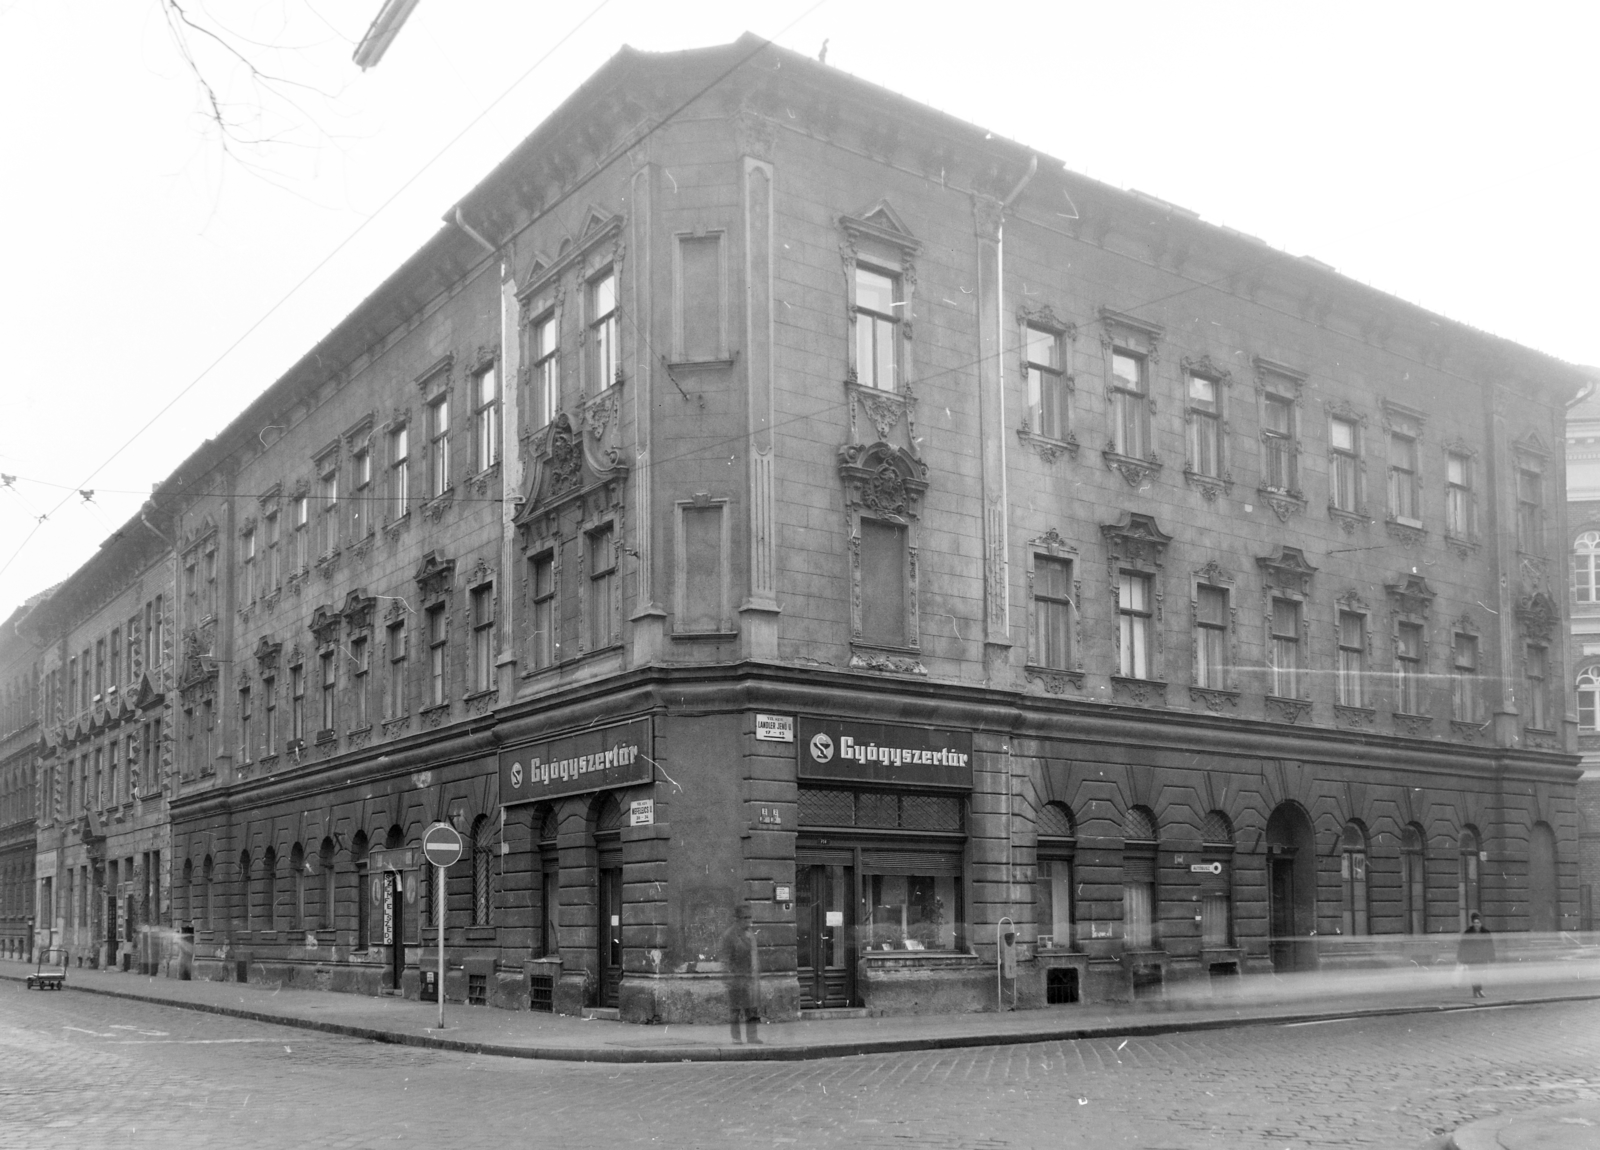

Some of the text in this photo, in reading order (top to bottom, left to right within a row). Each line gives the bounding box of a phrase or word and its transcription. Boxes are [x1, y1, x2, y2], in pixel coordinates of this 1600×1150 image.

[758, 721, 776, 729] LANDLER
[530, 742, 638, 785] Gyógyszertár
[840, 736, 968, 767] Gyógyszertár
